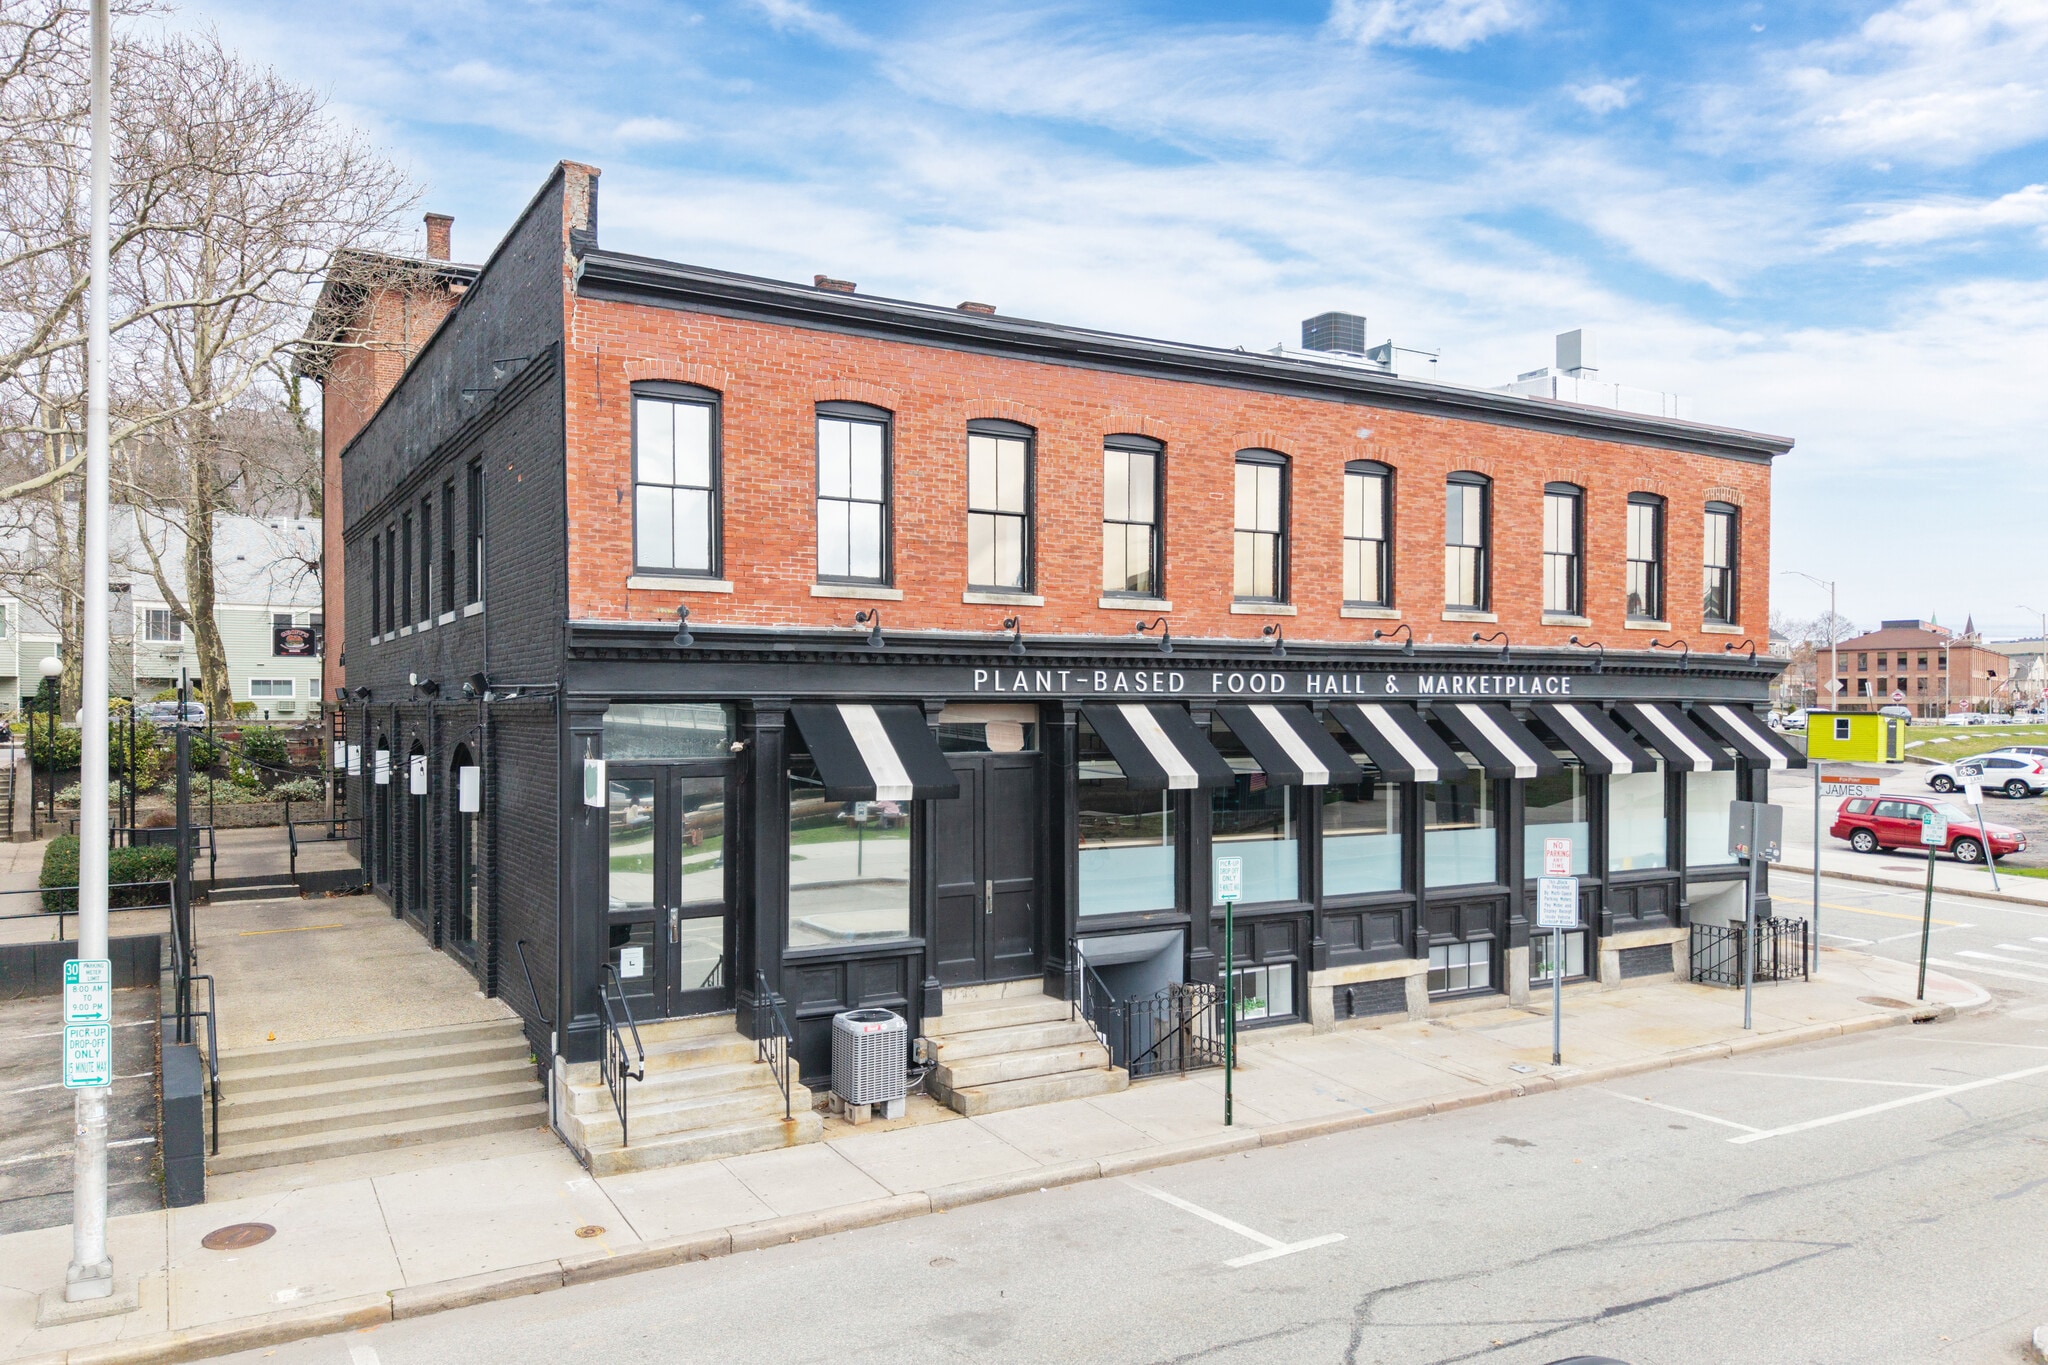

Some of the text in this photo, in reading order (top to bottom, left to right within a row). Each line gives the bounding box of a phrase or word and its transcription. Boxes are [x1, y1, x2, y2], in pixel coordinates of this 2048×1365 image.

[973, 669, 1571, 695] PLANT-BASED FOOD HALL & MARKETPLACE
[1825, 784, 1863, 796] JAMES
[1553, 842, 1564, 850] NO
[66, 963, 79, 976] 30
[83, 994, 92, 1002] TO
[70, 1028, 106, 1038] PICK-UP
[69, 1038, 106, 1049] DROP-OFF
[74, 1049, 101, 1059] ONLY
[76, 1061, 95, 1073] MINUTE
[96, 1060, 107, 1072] MAX
